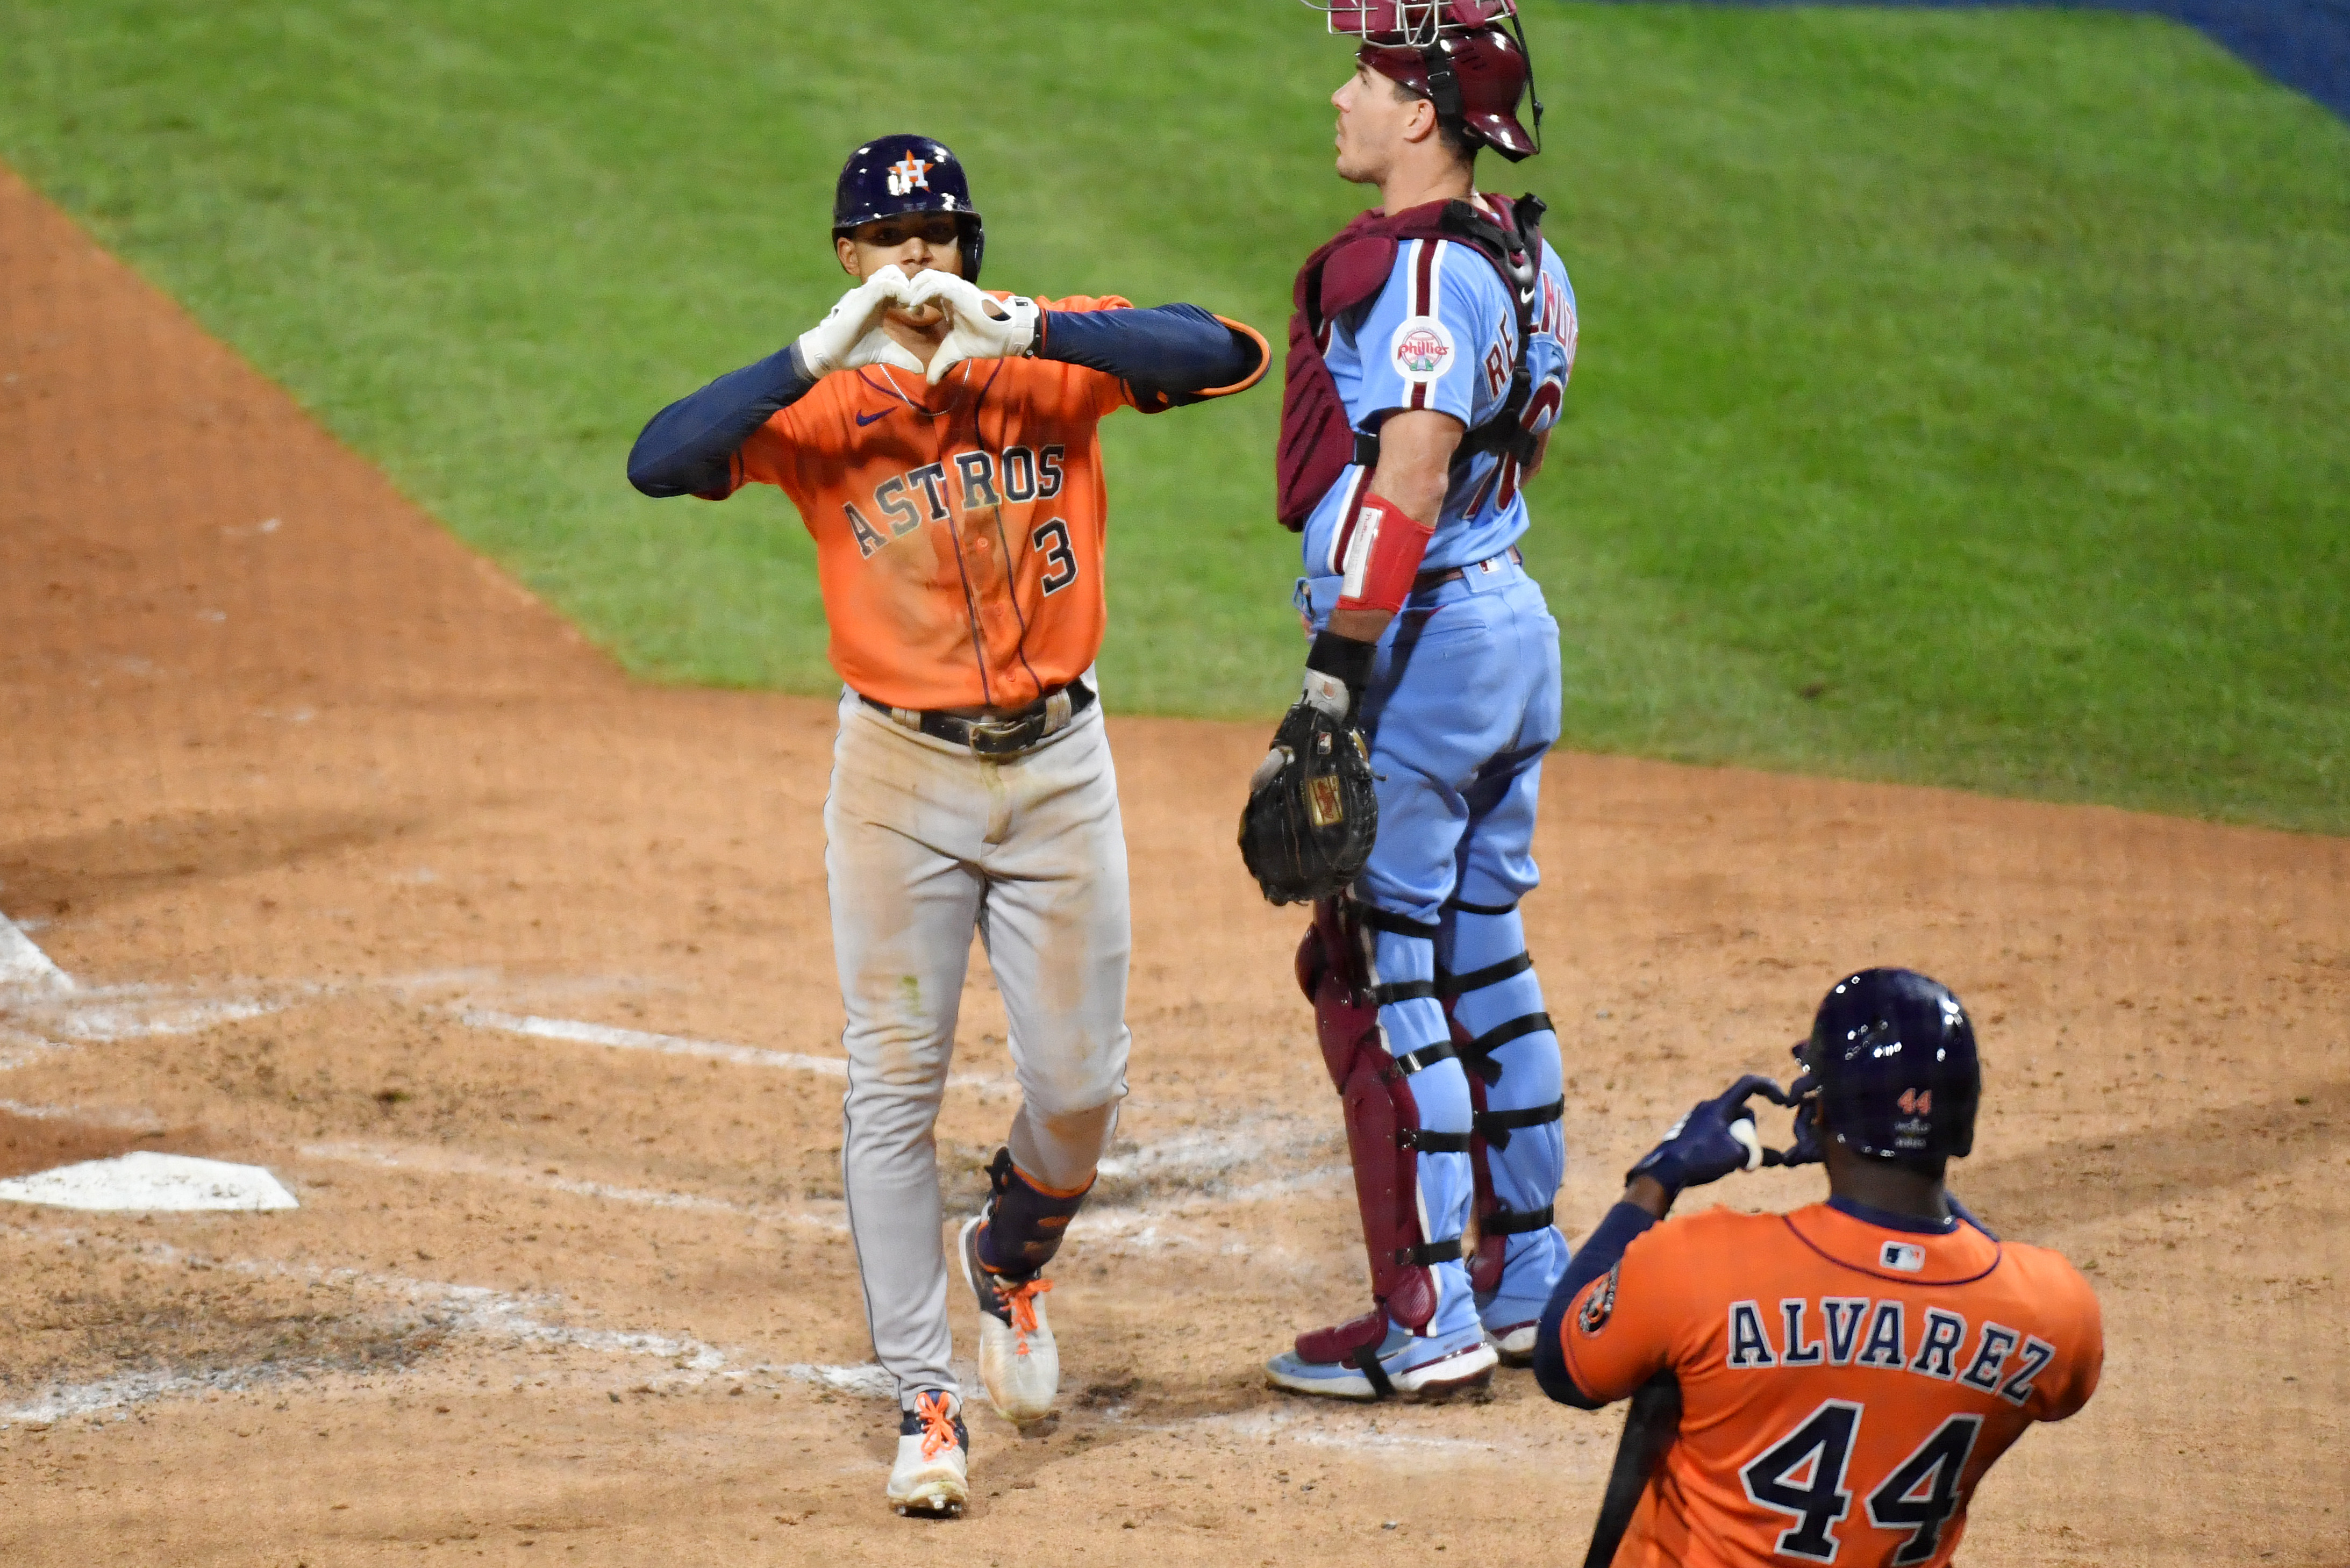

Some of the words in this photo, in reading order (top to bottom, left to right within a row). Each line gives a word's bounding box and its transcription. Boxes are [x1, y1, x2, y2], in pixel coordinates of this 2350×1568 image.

[842, 444, 1065, 560] ASTROS
[1033, 516, 1079, 597] 3
[1897, 1087, 1932, 1116] 44
[1726, 1296, 2056, 1407] ALVAREZ
[1739, 1398, 1984, 1566] 44
